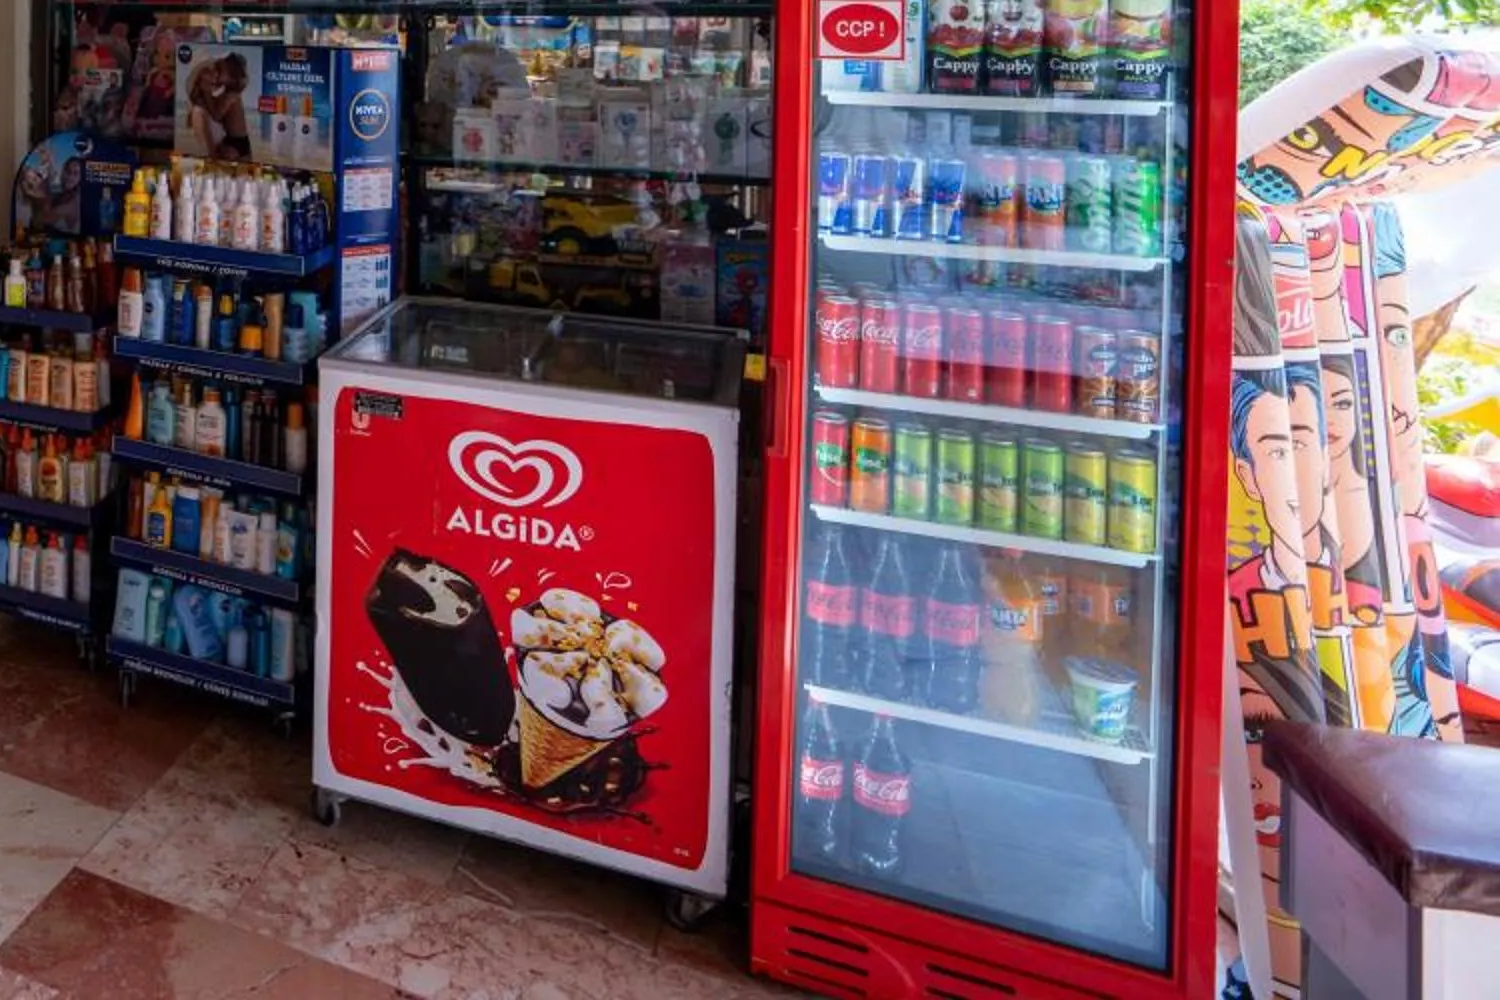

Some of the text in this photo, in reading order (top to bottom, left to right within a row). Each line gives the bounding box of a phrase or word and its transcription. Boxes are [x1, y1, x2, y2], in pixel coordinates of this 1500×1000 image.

[835, 20, 875, 37] CCP
[933, 57, 980, 73] Cappy
[1049, 57, 1099, 74] Cappy
[1114, 59, 1166, 77] Cappy
[355, 105, 384, 115] NIVEA
